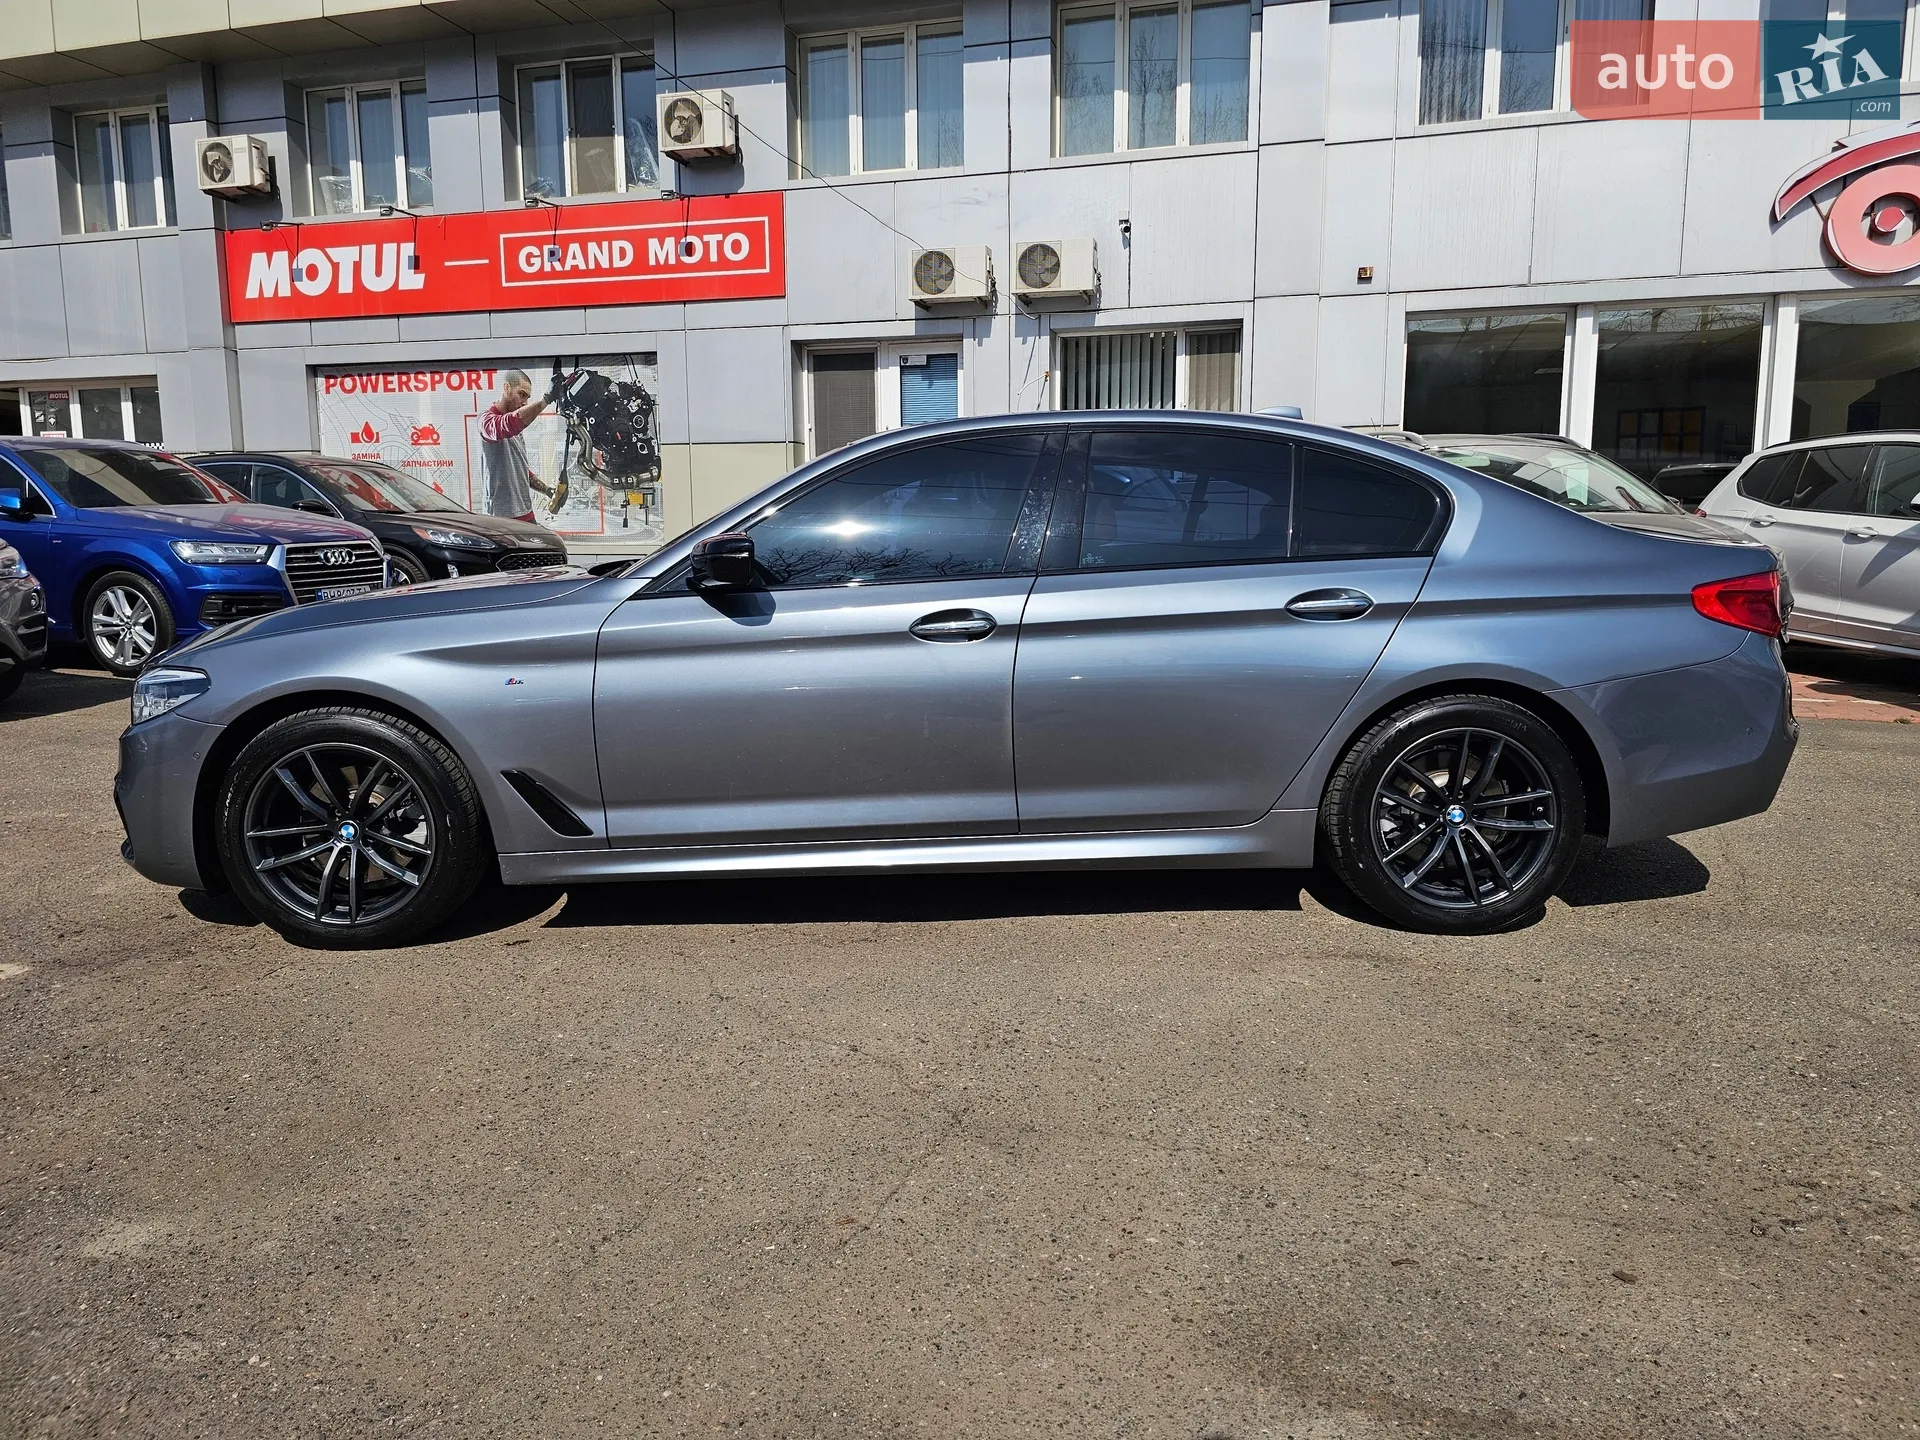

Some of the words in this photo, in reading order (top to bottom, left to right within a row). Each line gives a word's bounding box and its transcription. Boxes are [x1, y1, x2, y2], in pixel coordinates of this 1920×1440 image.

[245, 242, 426, 299] MOTUL
[519, 240, 633, 274] GRAND
[648, 232, 750, 267] MOTO
[324, 368, 498, 395] POWERSPORT
[352, 452, 381, 460] ЗАМІНА
[401, 460, 454, 468] ЗАПЧАСТИНИ
